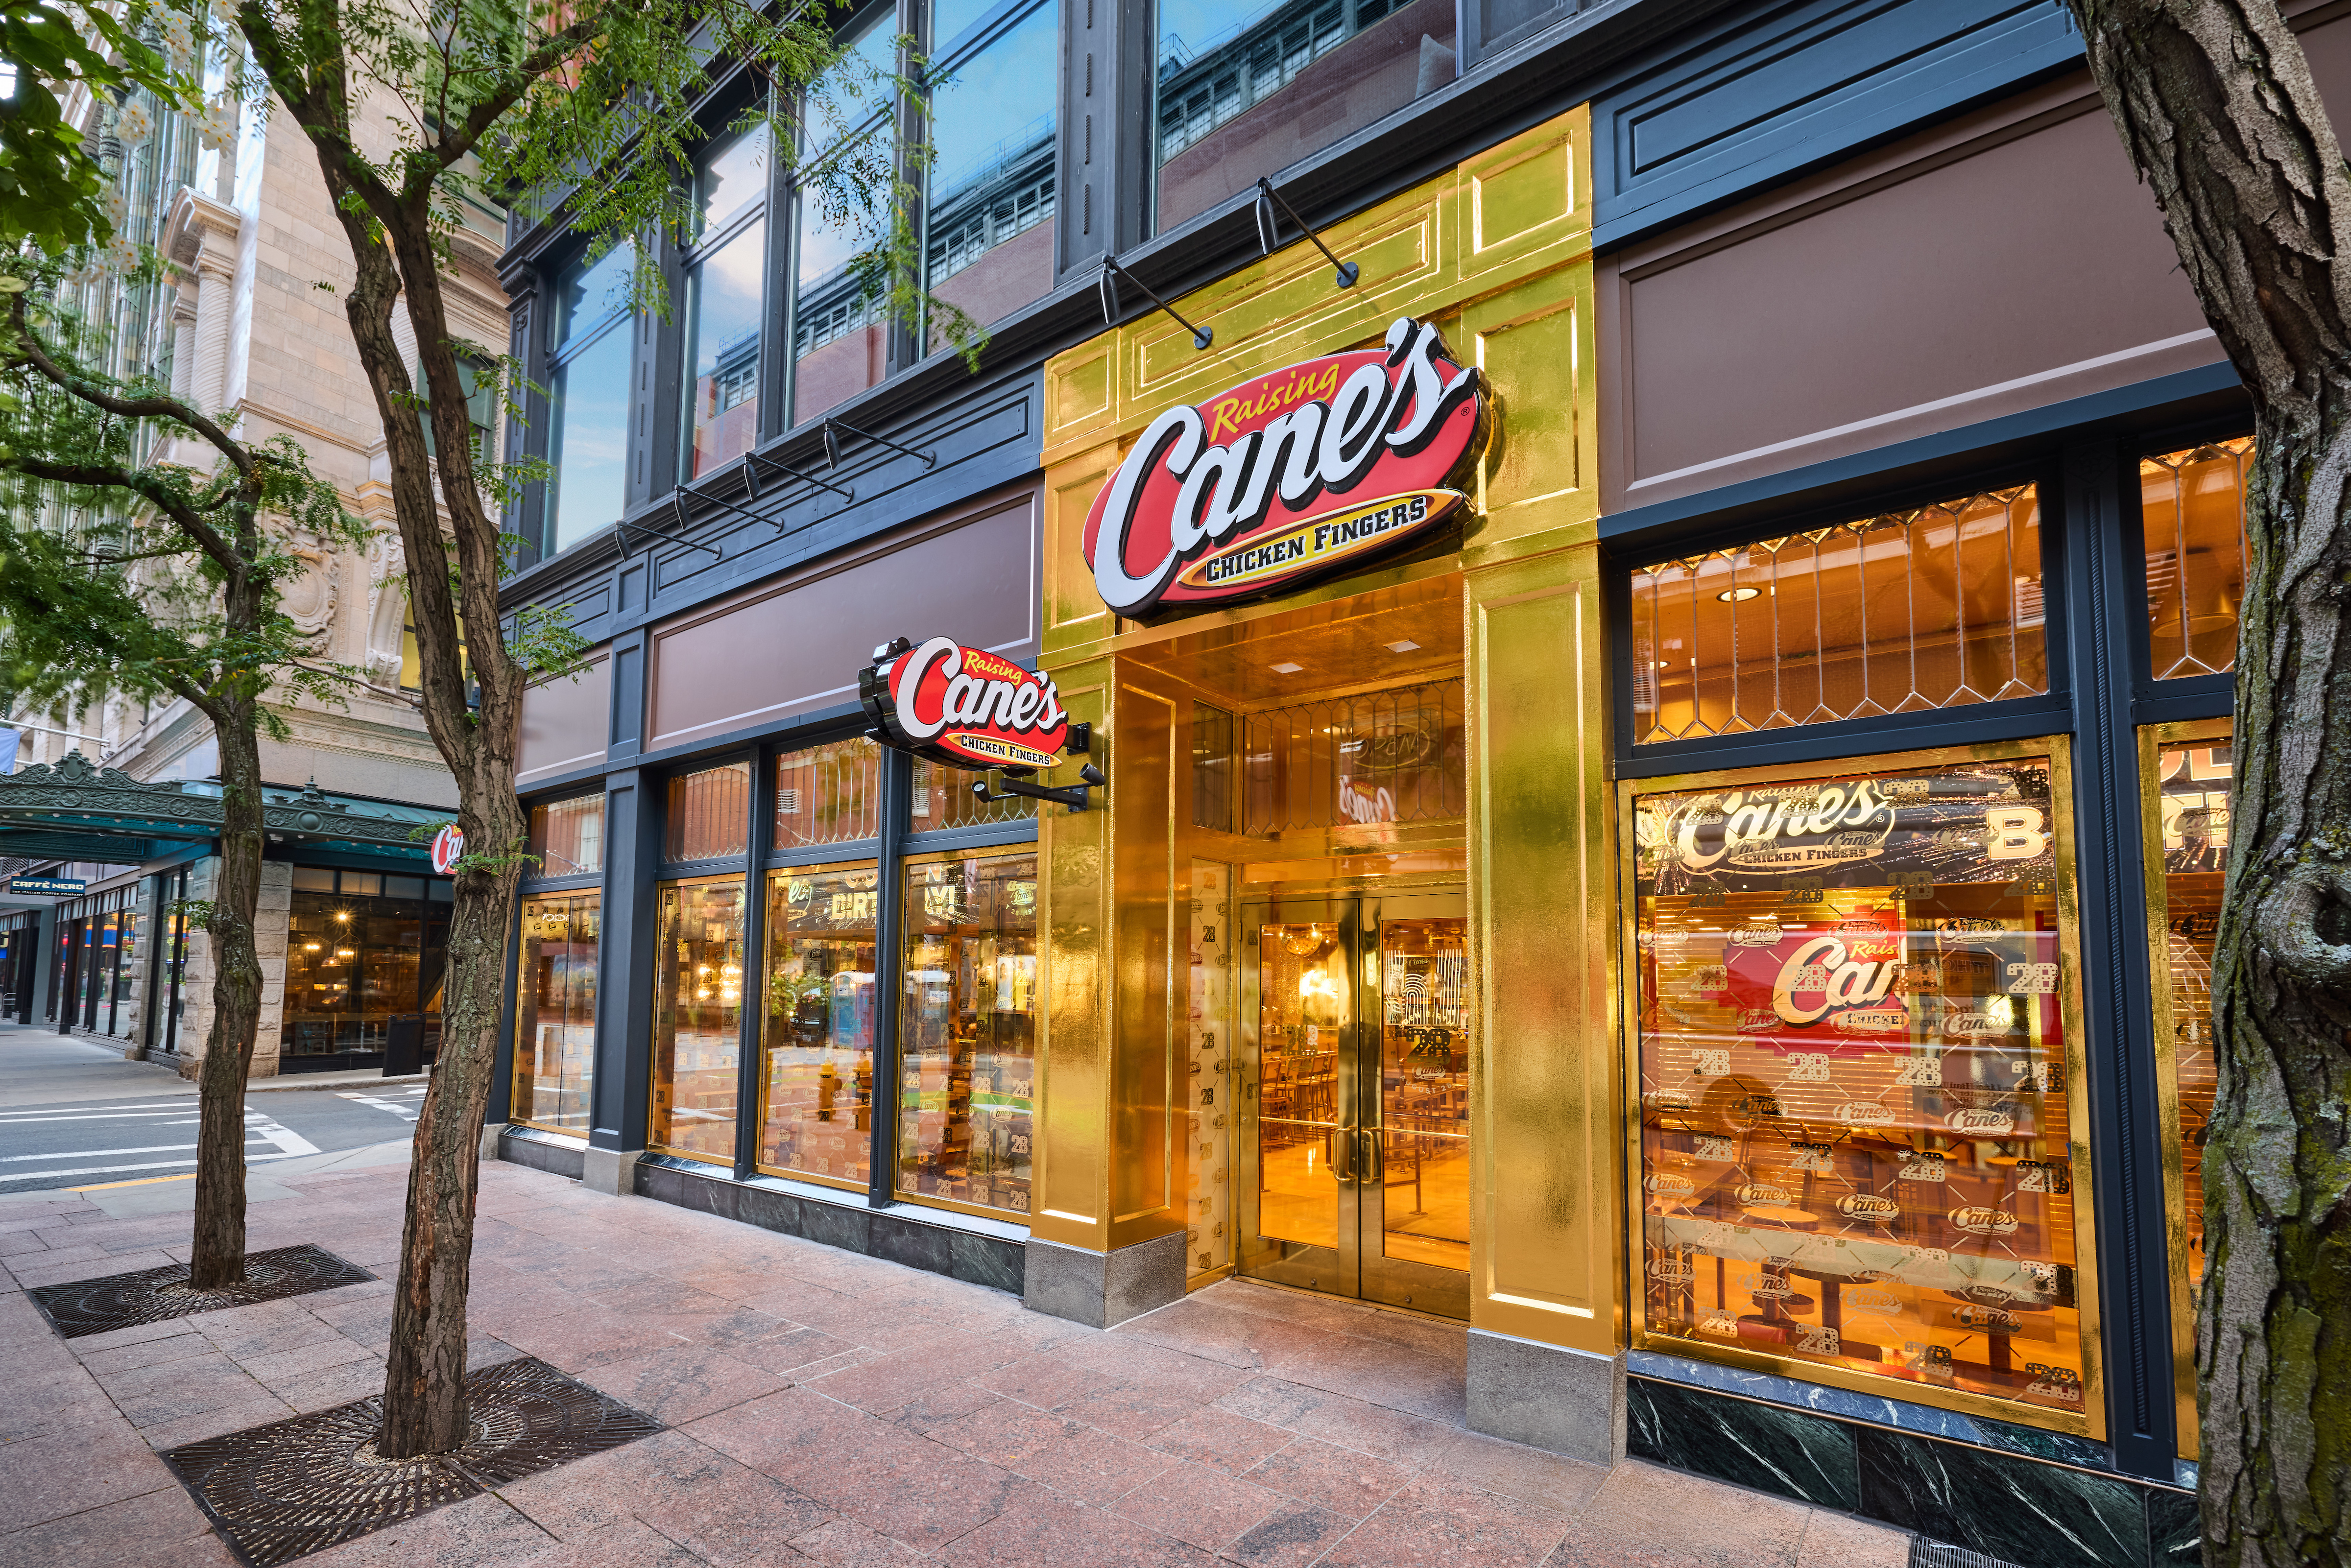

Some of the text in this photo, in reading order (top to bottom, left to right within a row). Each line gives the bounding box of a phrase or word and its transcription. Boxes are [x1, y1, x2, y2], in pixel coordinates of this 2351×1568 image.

[1210, 363, 1340, 442] Raising
[1094, 317, 1479, 608] Cane's
[1206, 496, 1427, 582] CHICKEN FINGERS
[964, 651, 1022, 685] Raising
[896, 636, 1067, 738] Cane's
[961, 735, 1050, 765] CHICKEN FINGERS
[1883, 779, 1930, 810] 28
[1827, 830, 1885, 856] Cane's
[1017, 860, 1032, 878] 28
[1782, 876, 1824, 904] 28
[1887, 871, 1934, 900] 28
[2003, 866, 2055, 897] 28
[1203, 926, 1215, 942] 28
[1690, 965, 1728, 991] 28
[1785, 964, 1827, 992] 28
[1891, 963, 1937, 992] 28
[2007, 963, 2059, 994] 28
[1202, 1032, 1214, 1049] 28
[1406, 1029, 1451, 1064] 28
[1413, 1063, 1446, 1079] Cane's
[1692, 1049, 1730, 1075] 28
[1788, 1052, 1830, 1081] 28
[1894, 1056, 1942, 1087] 28
[906, 1072, 920, 1088] 28
[939, 1075, 954, 1091] 28
[975, 1077, 990, 1094] 28
[1012, 1080, 1029, 1098] 28
[2012, 1061, 2064, 1093] 28
[698, 1095, 707, 1109] 28
[720, 1098, 730, 1112] 28
[1201, 1088, 1213, 1106] 28
[791, 1107, 802, 1122] 28
[818, 1110, 830, 1126] 28
[846, 1114, 859, 1130] 28
[1835, 1101, 1895, 1125] Cane's
[1947, 1108, 2014, 1133] Cane's
[905, 1122, 919, 1140] 28
[974, 1130, 989, 1148] 28
[696, 1137, 705, 1150] 28
[719, 1140, 728, 1155] 28
[1011, 1135, 1028, 1154] 28
[1200, 1142, 1212, 1161] 28
[1694, 1134, 1733, 1162] 28
[764, 1148, 774, 1164] 28
[790, 1153, 801, 1168] 28
[816, 1157, 828, 1173] 28
[1790, 1141, 1833, 1171] 28
[1898, 1150, 1945, 1182] 28
[845, 1162, 857, 1179] 28
[903, 1173, 917, 1191] 28
[2016, 1160, 2069, 1194] 28
[936, 1179, 952, 1197] 28
[973, 1184, 988, 1203] 28
[1645, 1173, 1694, 1195] Cane's
[1736, 1182, 1790, 1206] Cane's
[1010, 1190, 1027, 1210] 28
[1839, 1193, 1898, 1217] Cane's
[1951, 1205, 2018, 1231] Cane's
[1199, 1252, 1211, 1269] 28
[1647, 1257, 1696, 1280] Cane's
[1739, 1273, 1793, 1294] Cane's
[1841, 1288, 1901, 1311] Cane's
[1698, 1306, 1738, 1338] 28
[1955, 1304, 2022, 1330] Cane's
[1796, 1323, 1839, 1357] 28
[1904, 1341, 1953, 1377] 28
[2025, 1362, 2079, 1401] 28
